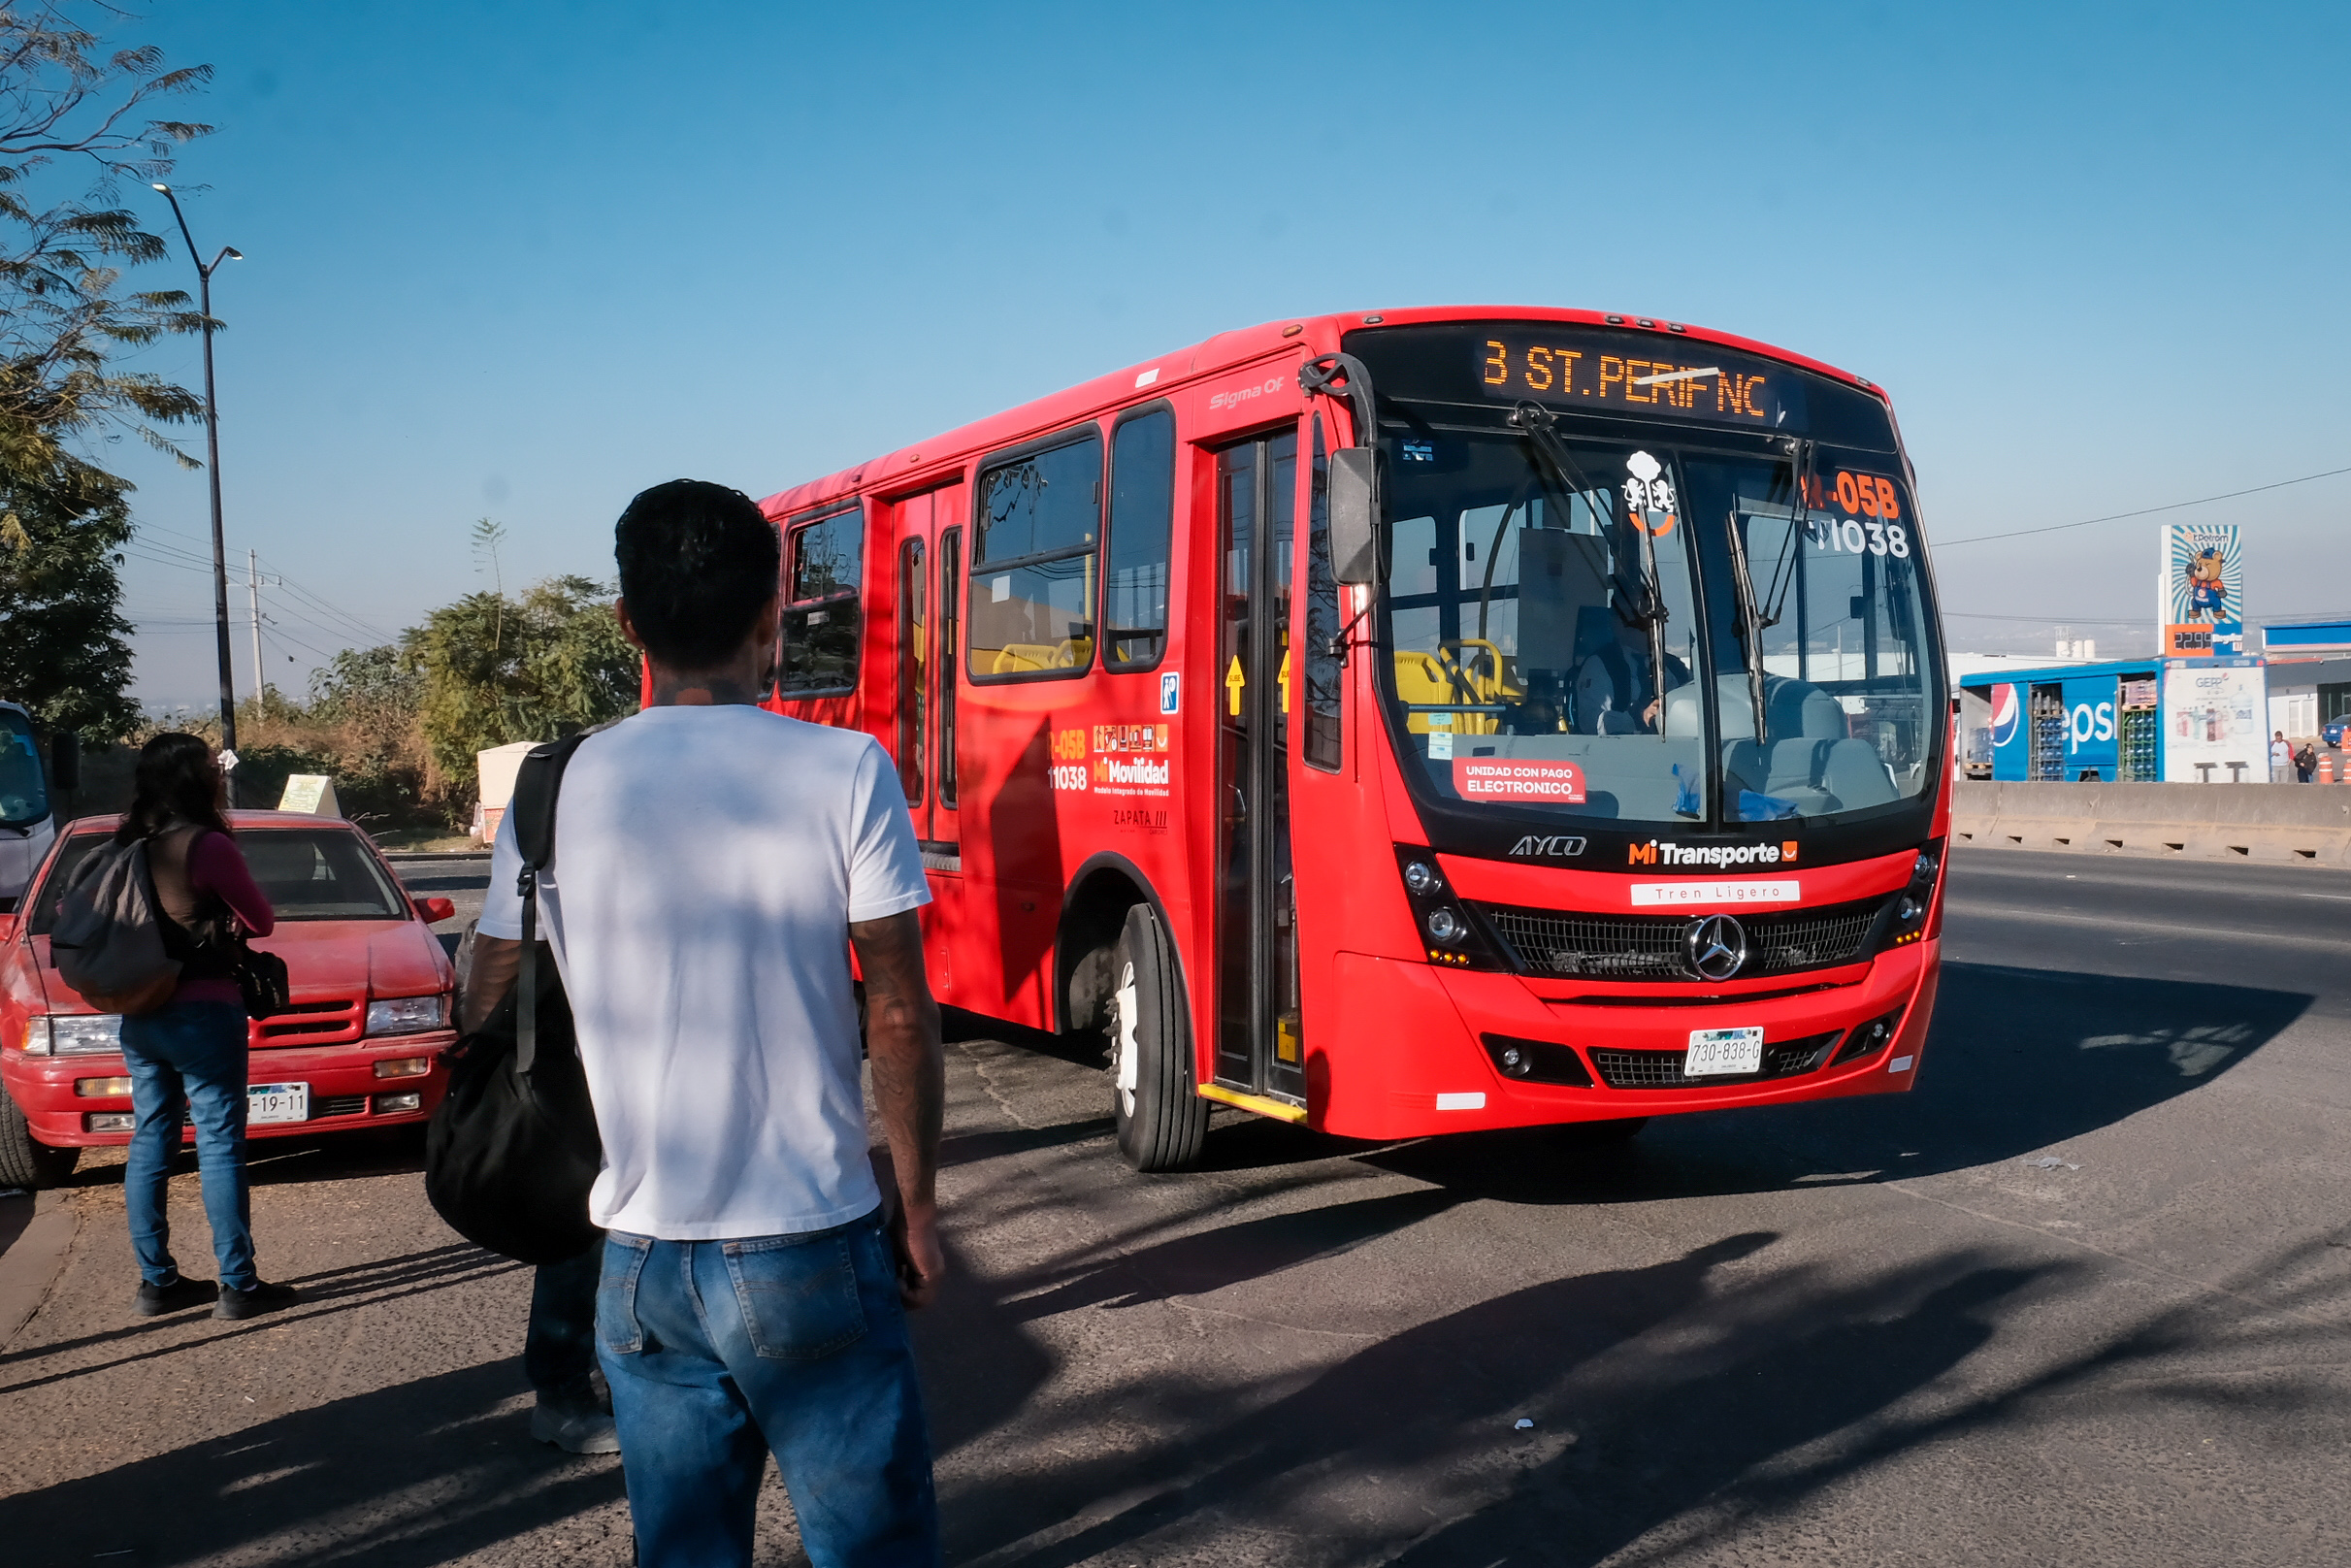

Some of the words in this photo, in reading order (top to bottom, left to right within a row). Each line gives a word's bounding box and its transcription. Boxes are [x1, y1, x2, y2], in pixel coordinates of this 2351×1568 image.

[1209, 385, 1262, 409] Sigma
[1048, 766, 1087, 791] 11038
[1094, 756, 1108, 782] Mi
[1109, 756, 1169, 785] Movilidad
[1465, 766, 1512, 777] UNIDAD
[1513, 767, 1540, 777] CON
[1541, 768, 1573, 779] PAGO
[1466, 779, 1573, 795] ELECTRONICO
[1114, 809, 1152, 826] ZAPATA
[1508, 835, 1587, 857] AYCO
[1628, 839, 1657, 866] Mi
[1659, 840, 1780, 869] Transporte
[1655, 888, 1702, 900] Tren
[1715, 886, 1780, 900] Ligero
[1692, 1040, 1760, 1063] 730-838-G
[246, 1094, 304, 1114] -19-11
